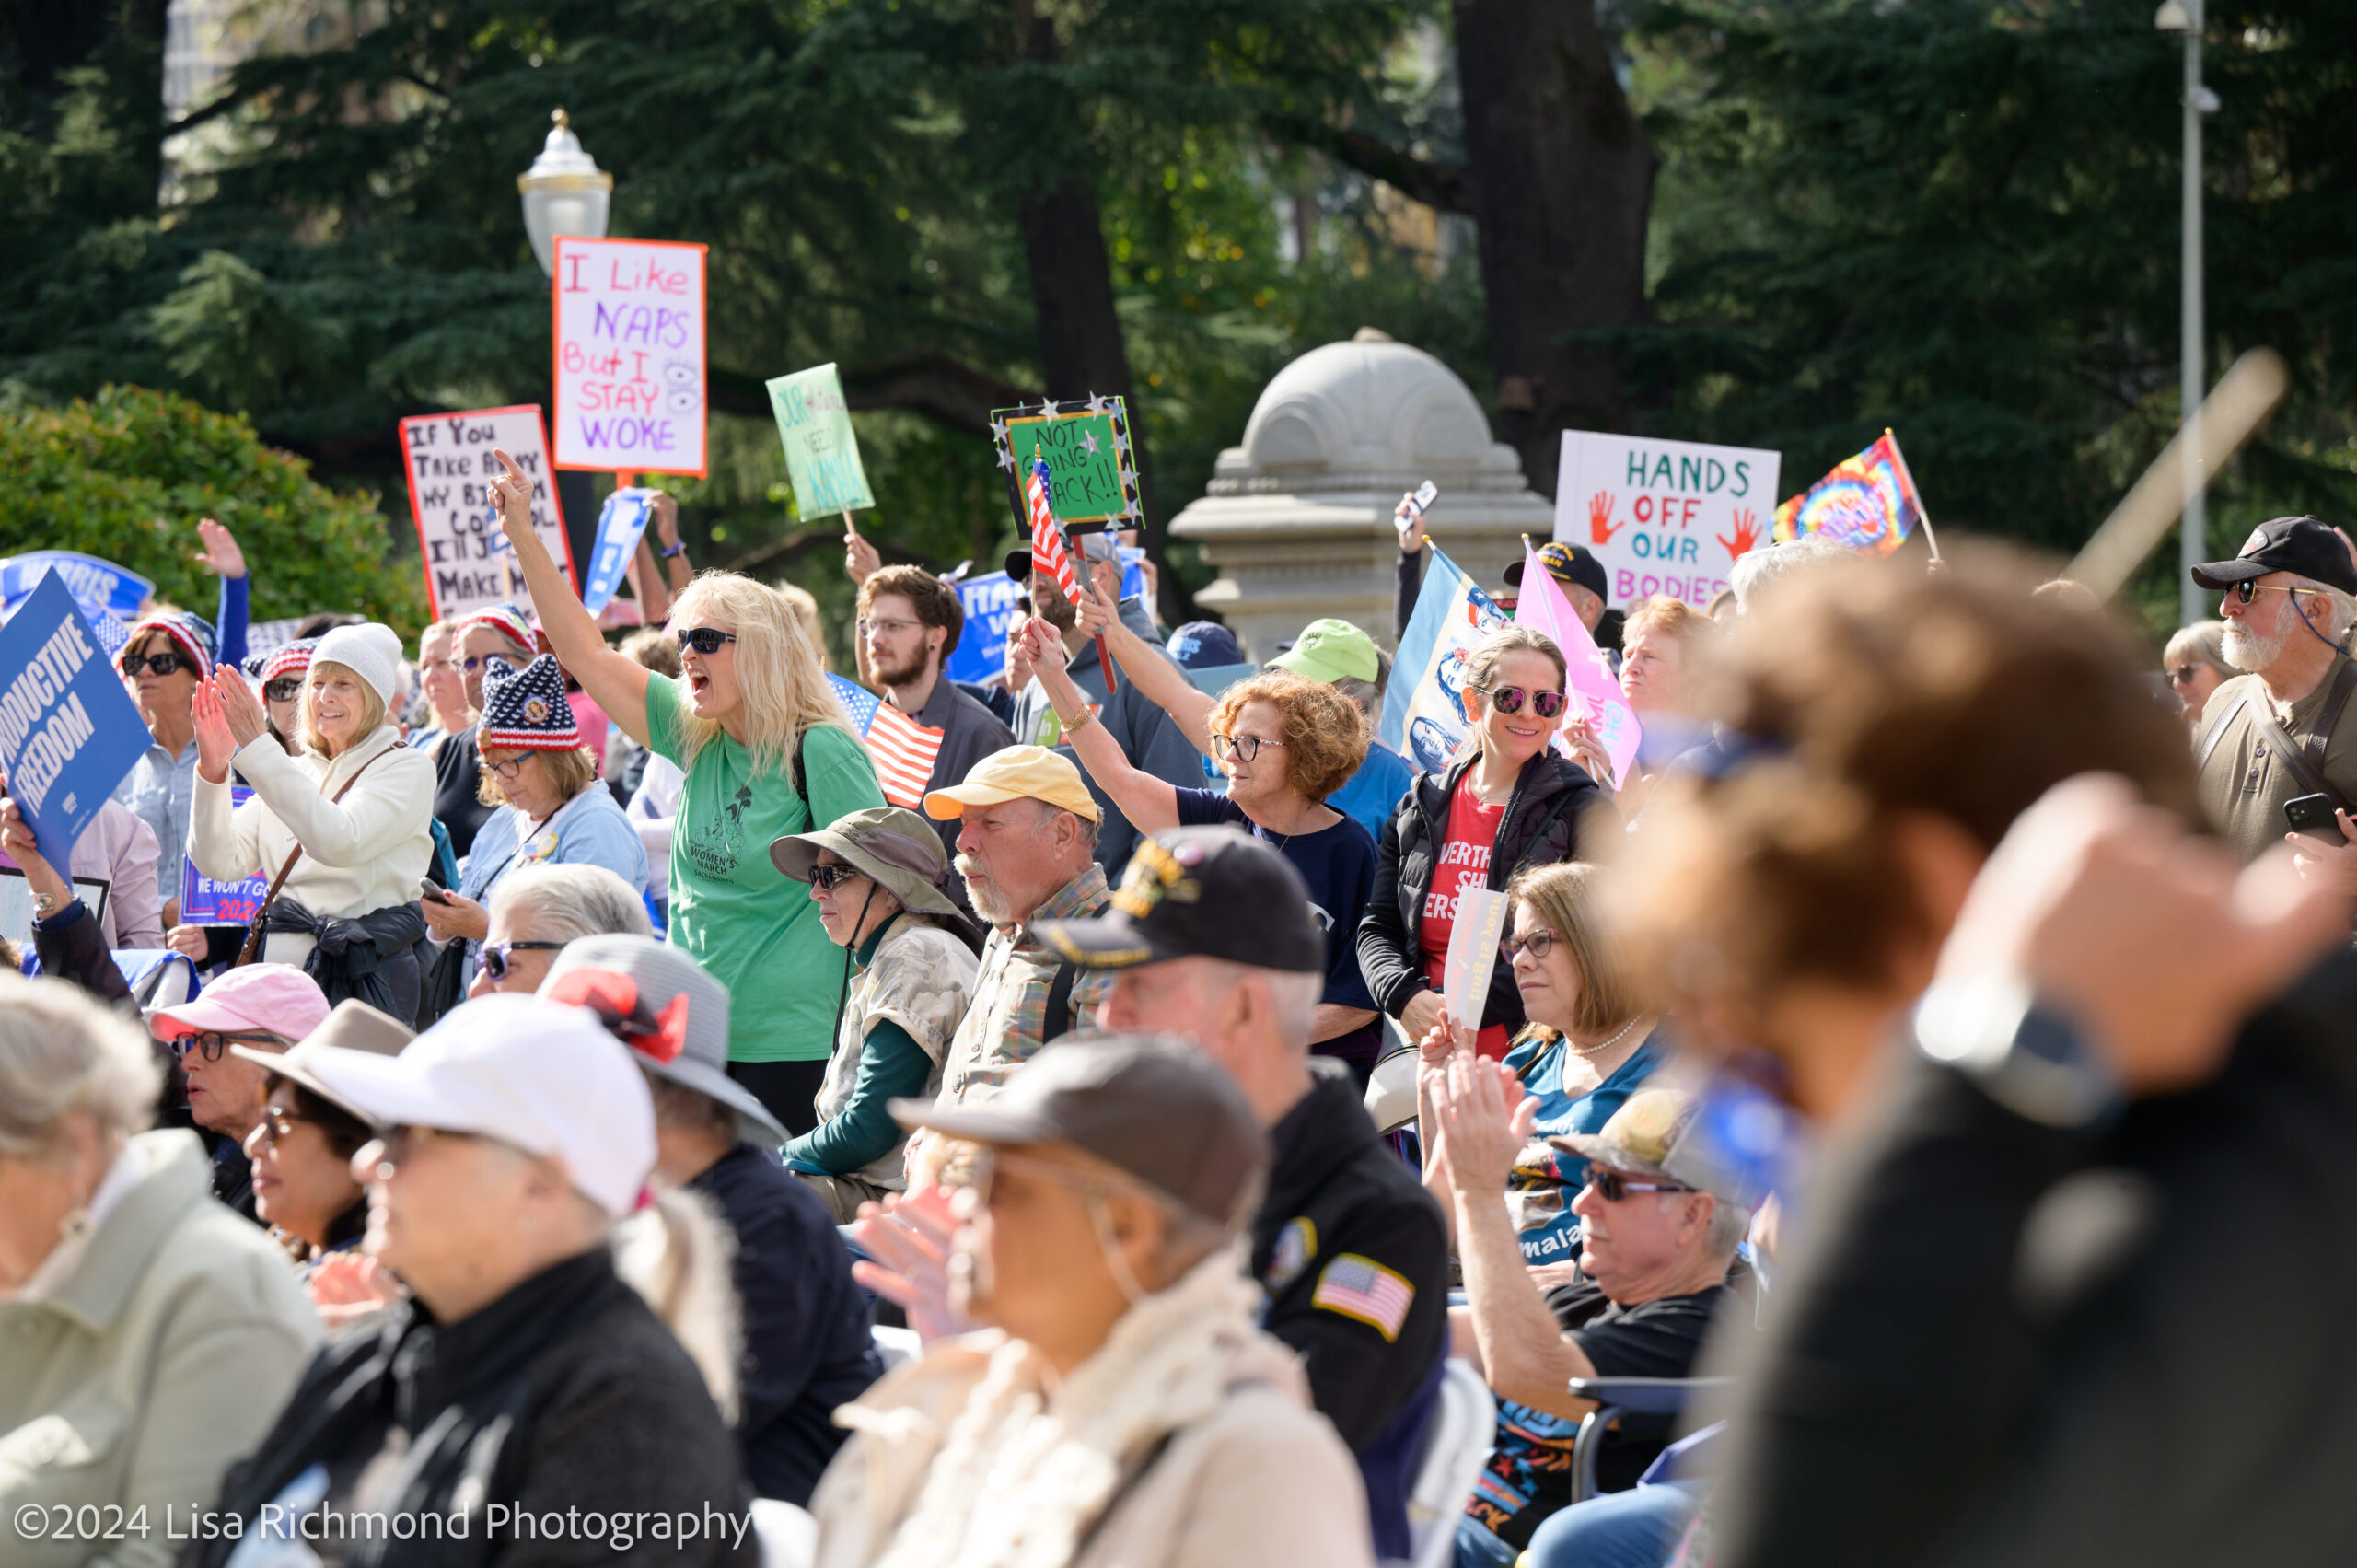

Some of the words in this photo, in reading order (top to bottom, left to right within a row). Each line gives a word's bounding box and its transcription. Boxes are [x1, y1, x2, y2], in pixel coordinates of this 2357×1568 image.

[563, 253, 590, 293] I
[610, 255, 689, 296] Like
[593, 300, 690, 349] NAPS
[563, 341, 623, 377] But
[630, 350, 650, 384] I
[576, 380, 660, 415] STAY
[407, 424, 436, 447] IF
[579, 415, 676, 452] WOKE
[1035, 420, 1078, 448] NOT
[1051, 459, 1119, 508] ACK!!
[1627, 450, 1750, 497] HANDS
[1633, 495, 1701, 529] OFF
[1631, 532, 1699, 565] OUR
[14, 691, 95, 819] FREEDOM
[691, 846, 736, 869] WOMEN'S
[697, 860, 727, 876] MARCH
[197, 877, 211, 893] WE
[213, 878, 252, 894] WON'T
